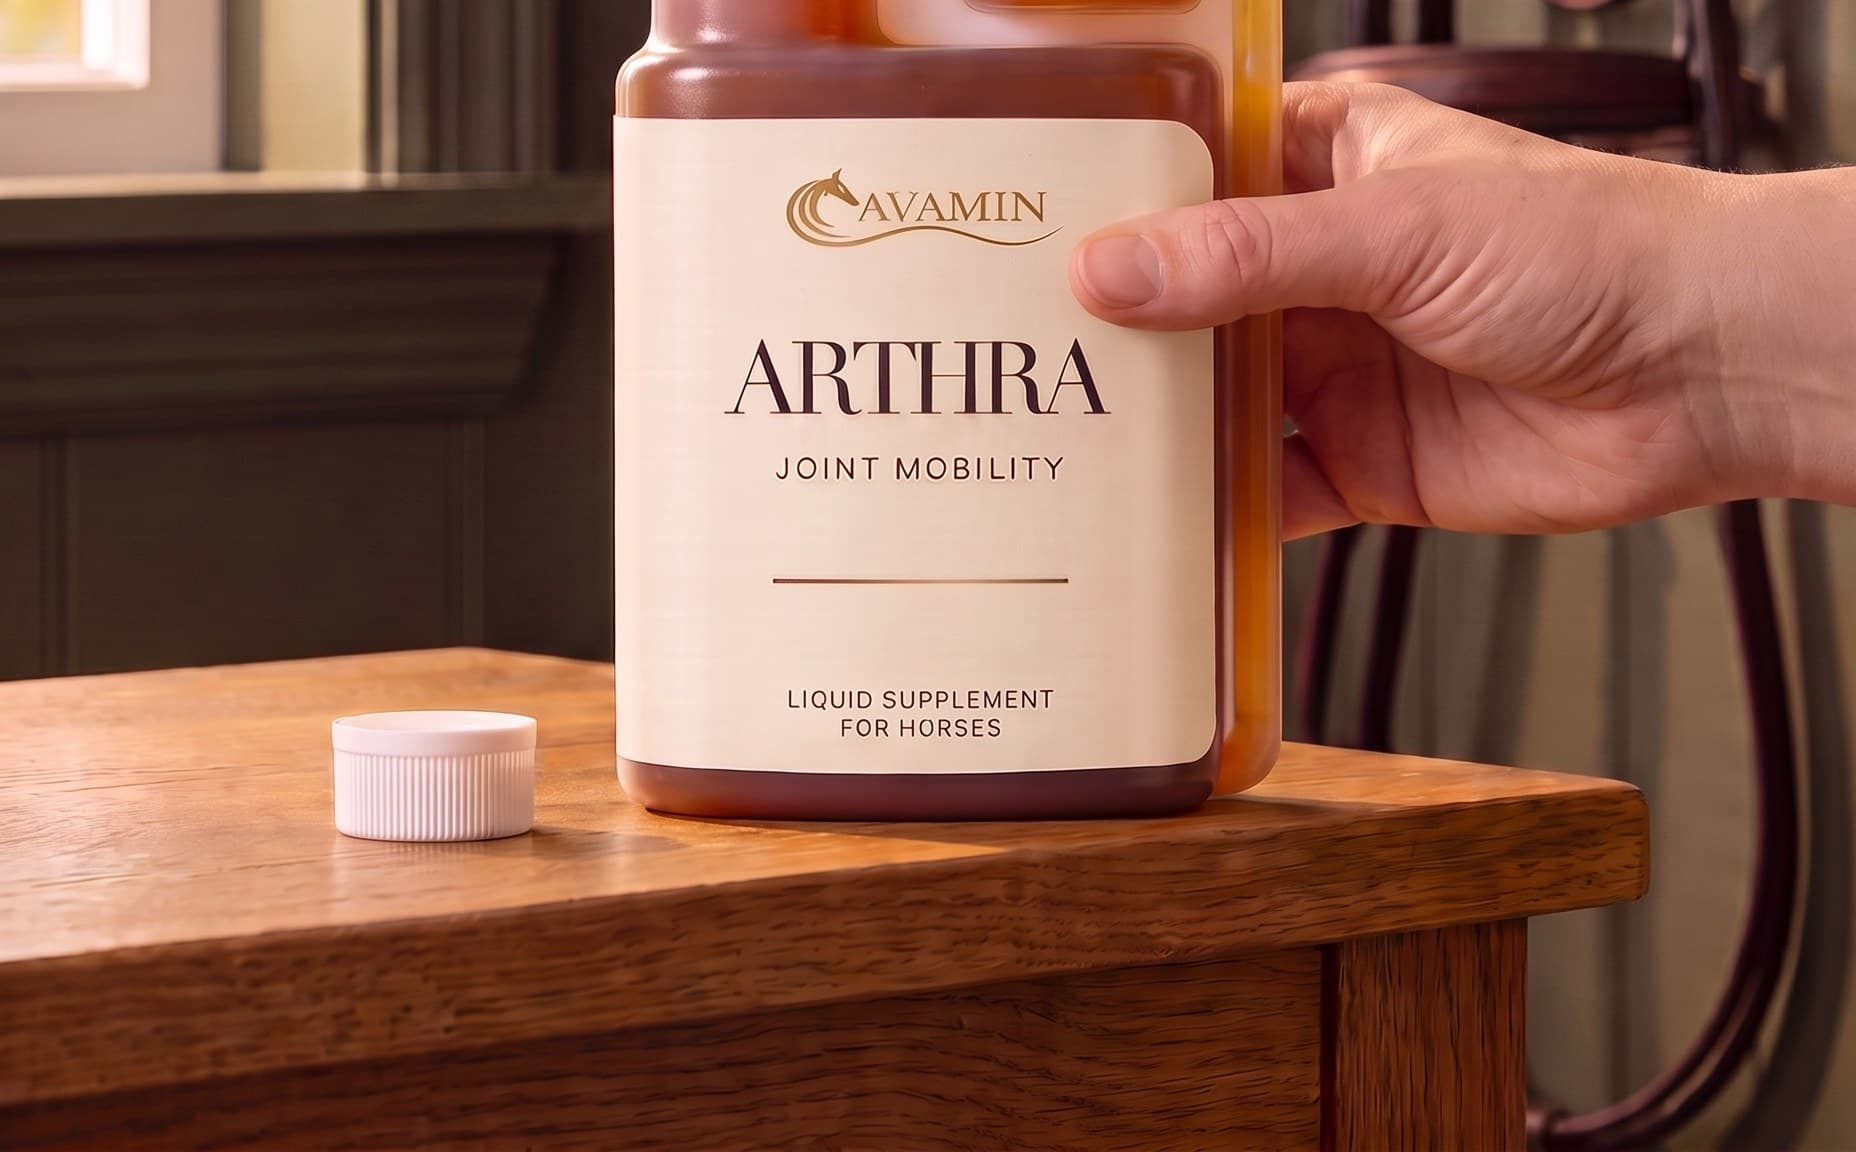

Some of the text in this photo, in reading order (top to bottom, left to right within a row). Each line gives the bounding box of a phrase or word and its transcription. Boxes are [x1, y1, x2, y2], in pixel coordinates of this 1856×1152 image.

[723, 337, 1112, 416] ARTHRA
[775, 456, 1065, 481] JOINT MOBILITY
[787, 689, 1055, 711] LIQUID SUPPLEMENT
[840, 718, 1002, 738] FOR HORSES
